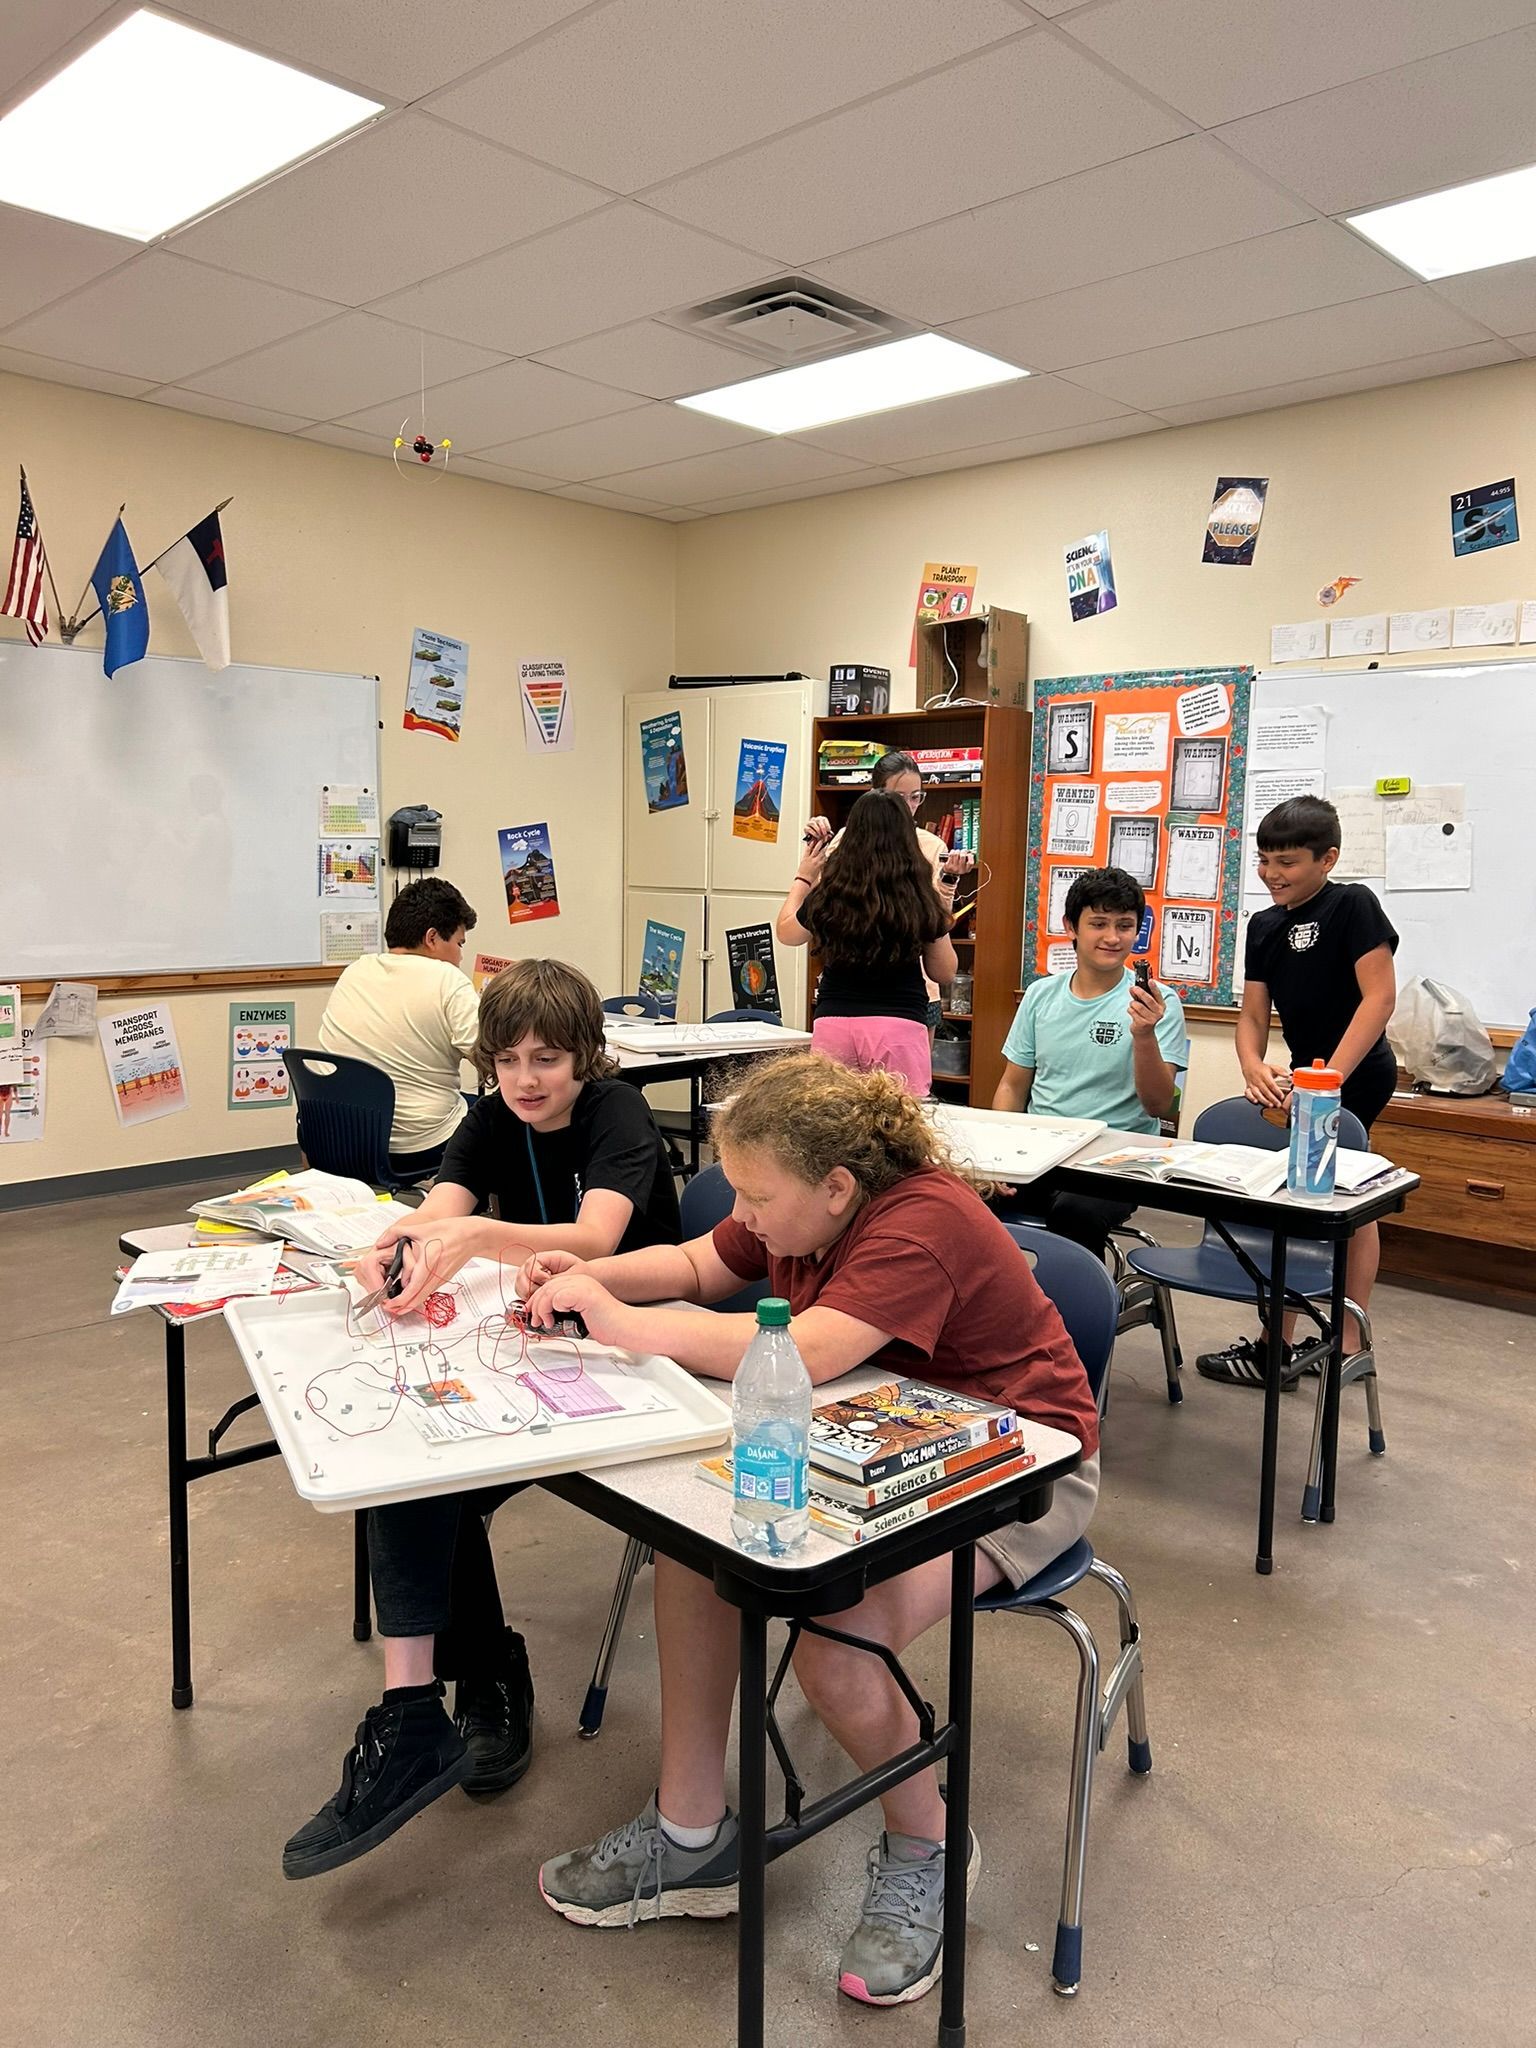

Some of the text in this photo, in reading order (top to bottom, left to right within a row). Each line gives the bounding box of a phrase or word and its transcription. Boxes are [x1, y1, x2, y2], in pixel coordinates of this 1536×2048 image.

[1456, 495, 1472, 510] 21
[1212, 522, 1252, 536] PLEASE
[1464, 508, 1507, 542] Sc
[1066, 543, 1098, 564] SCIENCE
[941, 566, 960, 575] PLANT
[932, 574, 967, 584] TRANSPORT
[1068, 568, 1096, 594] DNA
[422, 633, 436, 642] Plate
[437, 638, 462, 650] Tectonics
[522, 662, 562, 671] CLASSIFICATION
[862, 668, 888, 676] OVENTE
[1057, 712, 1086, 723] WANTED
[743, 742, 785, 754] Volcanic Eruption
[1065, 730, 1078, 758] S
[917, 750, 954, 760] OPERATION
[1184, 748, 1217, 758] WANTED
[828, 758, 858, 766] MONOPOLY
[1057, 788, 1095, 799] WANTED
[507, 829, 540, 840] Rock Cycle
[1119, 827, 1150, 837] WANTED
[1178, 830, 1214, 839] WANTED
[1171, 912, 1206, 921] WANTED
[657, 929, 670, 938] Water
[670, 933, 683, 942] Cycle
[729, 929, 770, 941] Earth's Structure
[1177, 935, 1200, 960] Na
[481, 958, 503, 968] ORGANS
[112, 1010, 158, 1030] TRANSPORT
[240, 1010, 287, 1021] ENZYMES
[122, 1021, 154, 1036] ACROSS
[114, 1026, 164, 1046] MEMBRANES
[747, 1446, 779, 1460] DASANI
[901, 1443, 937, 1468] DOG MAN
[884, 1473, 926, 1500] Science
[930, 1466, 937, 1480] 6
[874, 1507, 914, 1533] Science 6
